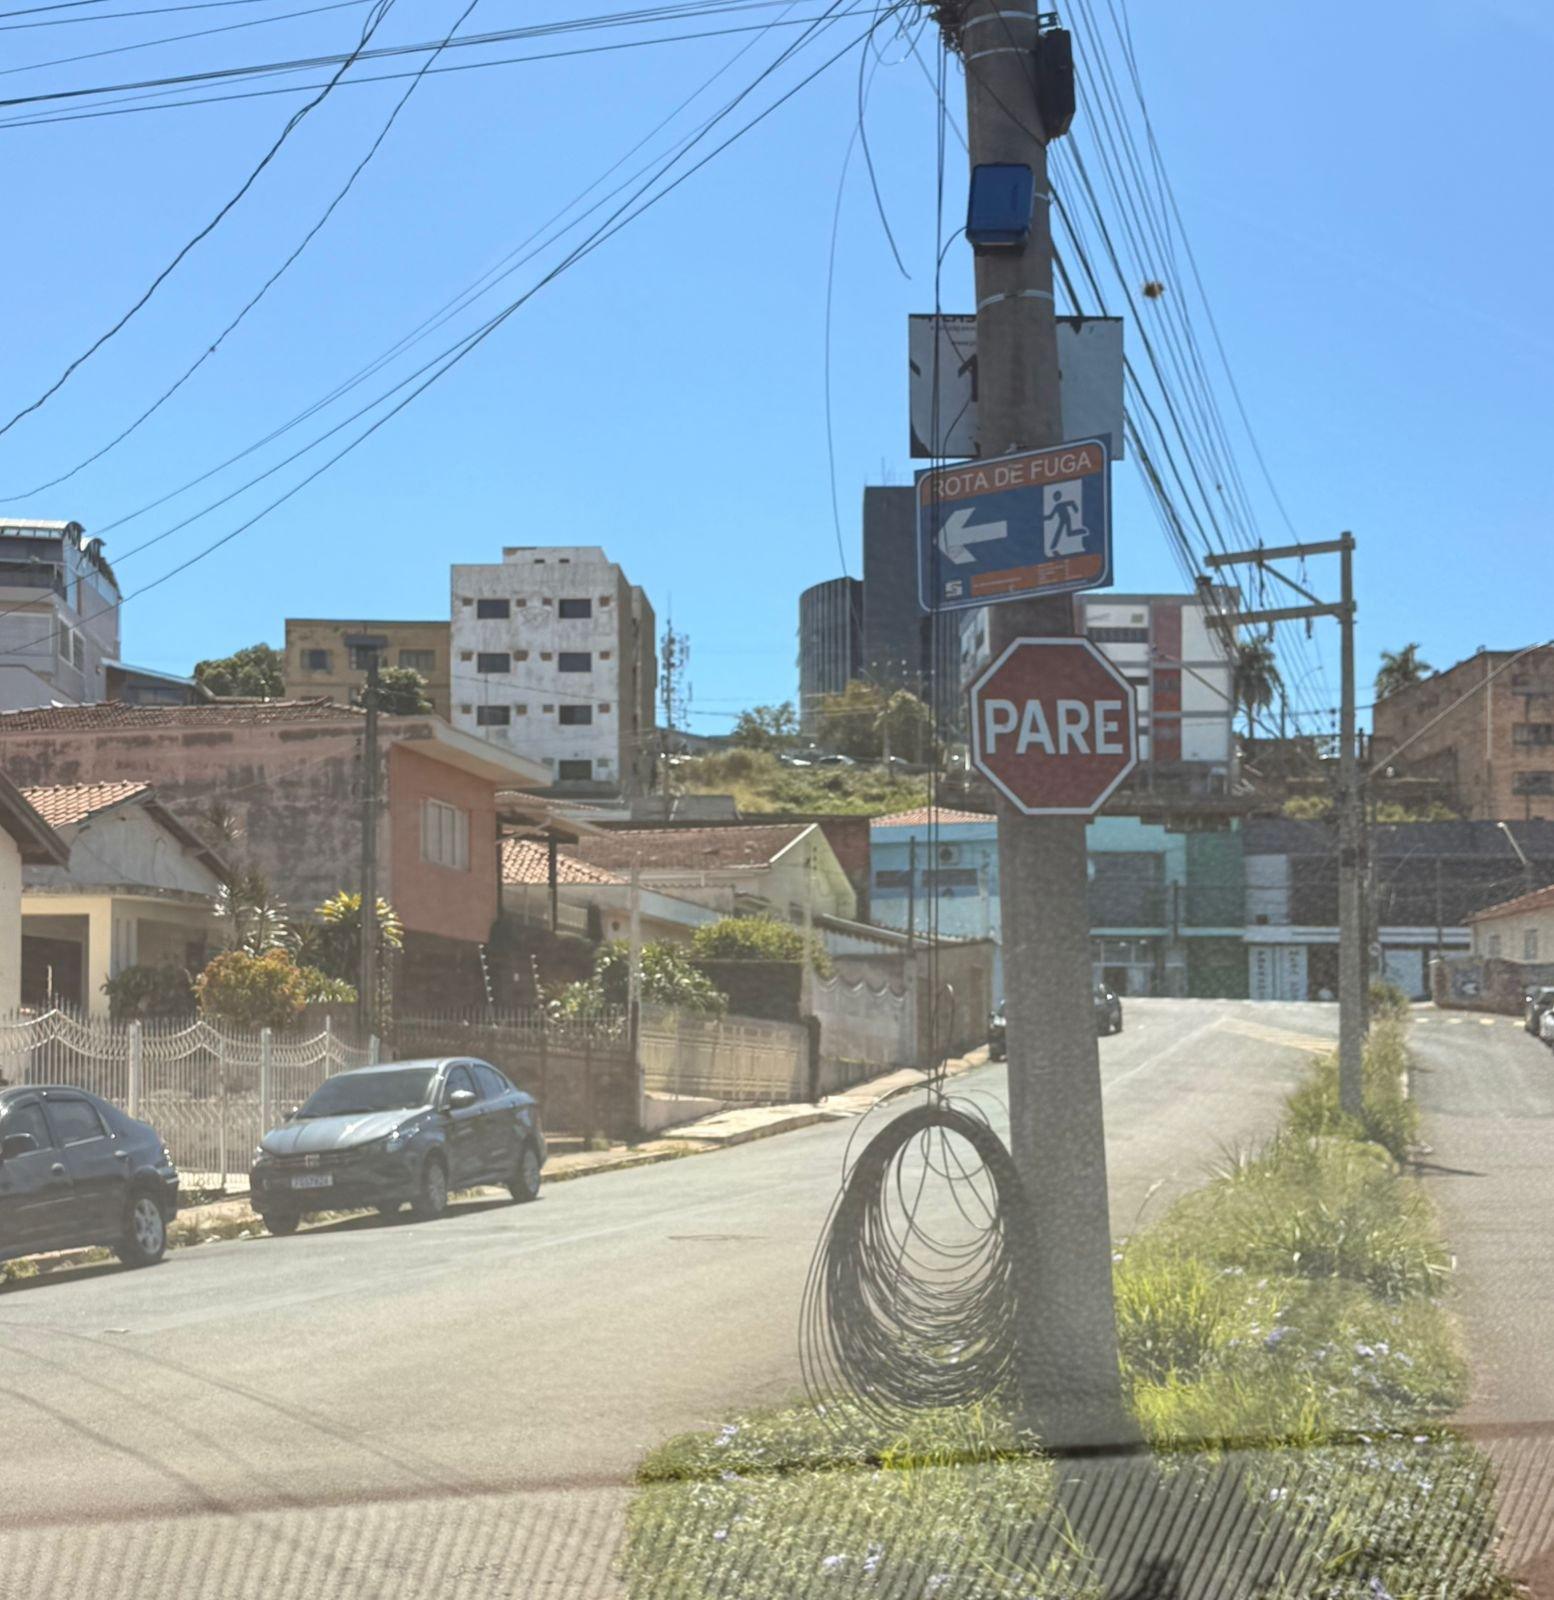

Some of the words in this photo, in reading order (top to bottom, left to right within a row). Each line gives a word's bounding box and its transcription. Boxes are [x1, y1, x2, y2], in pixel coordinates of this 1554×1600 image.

[995, 464, 1024, 487] DE
[1031, 451, 1092, 480] FUGA
[984, 699, 1124, 755] PARE
